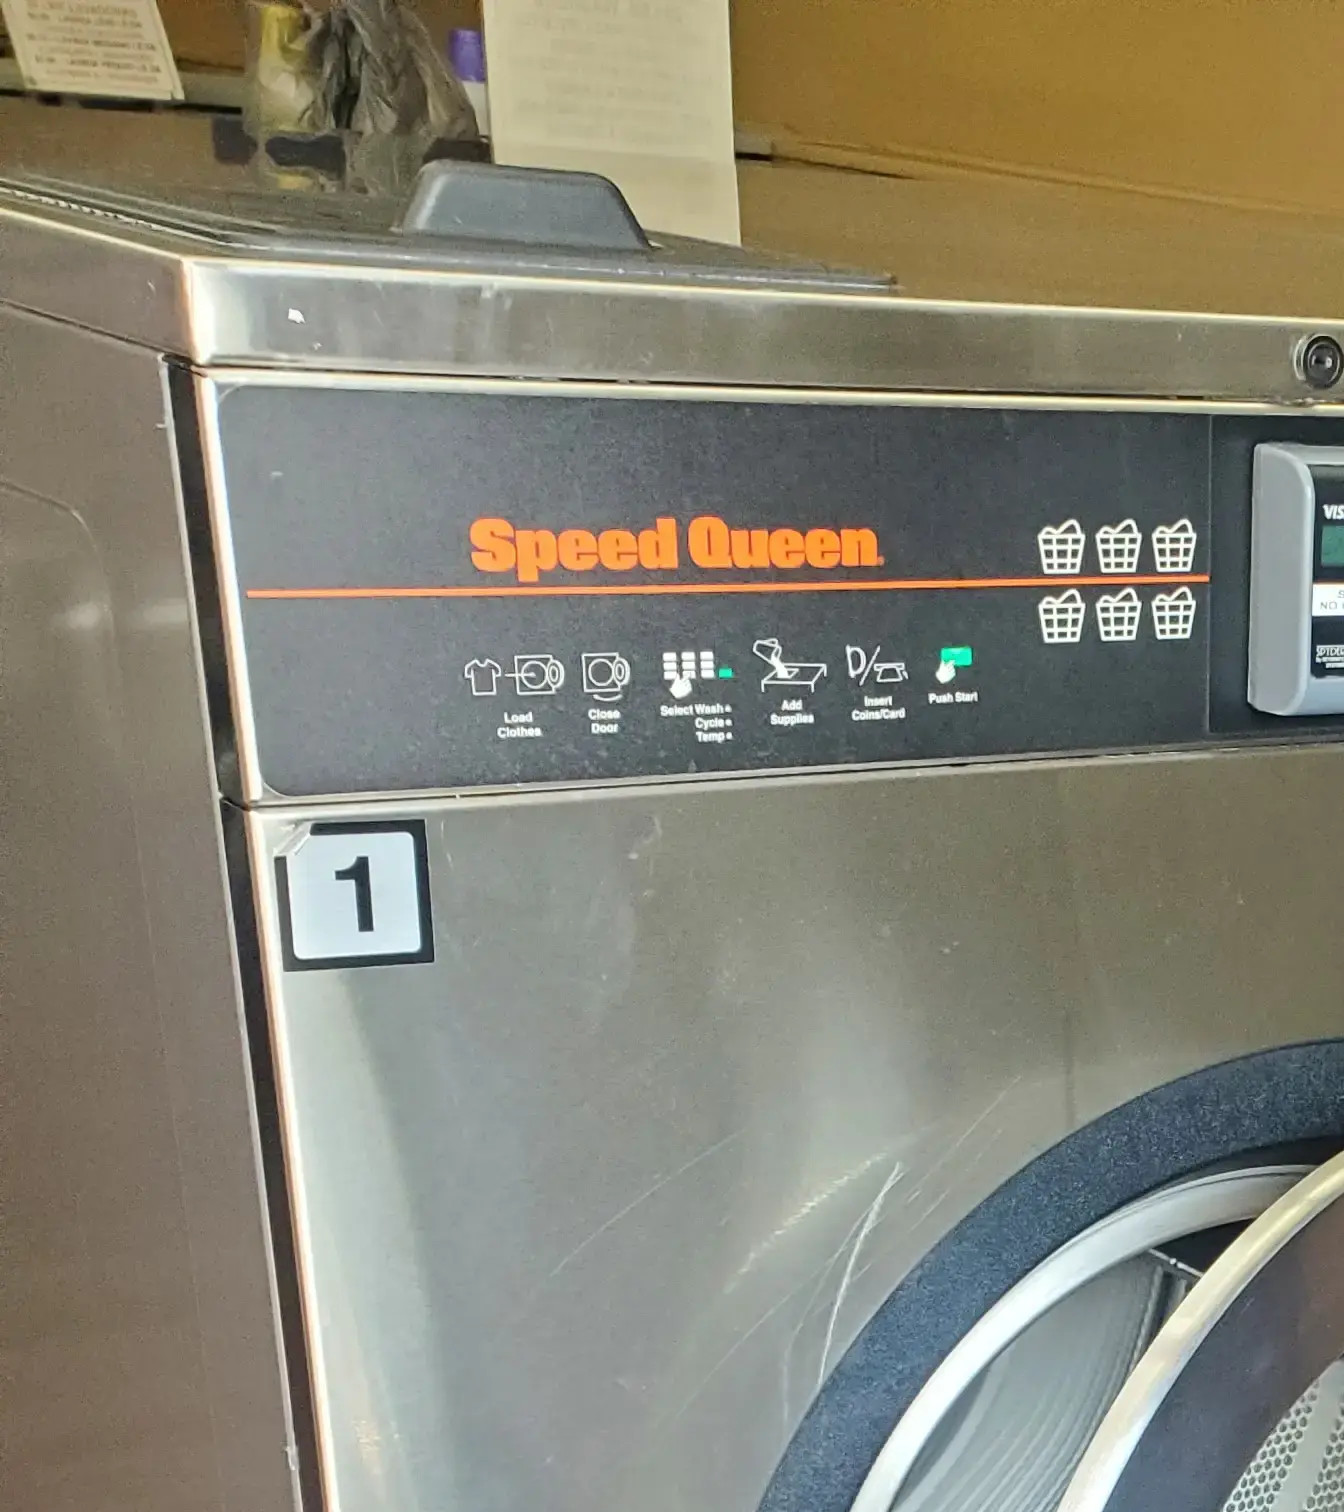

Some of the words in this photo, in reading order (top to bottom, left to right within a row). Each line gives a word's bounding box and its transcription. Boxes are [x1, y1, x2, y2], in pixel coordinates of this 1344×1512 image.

[470, 517, 679, 582] Speed
[687, 516, 879, 569] Queen
[1320, 602, 1338, 610] NO
[864, 696, 893, 706] Insert
[928, 692, 954, 704] Push
[955, 691, 978, 703] Start
[660, 705, 693, 716] Select
[694, 703, 724, 715] Wash
[781, 699, 802, 711] Add
[503, 711, 533, 724] Load
[588, 709, 621, 720] Close
[770, 713, 814, 726] Supplies
[851, 708, 906, 721] Coins/Card
[591, 722, 619, 734] Door
[695, 717, 724, 730] Cycle
[497, 726, 542, 738] Clothes
[696, 731, 724, 743] Temp
[335, 855, 374, 932] 1
